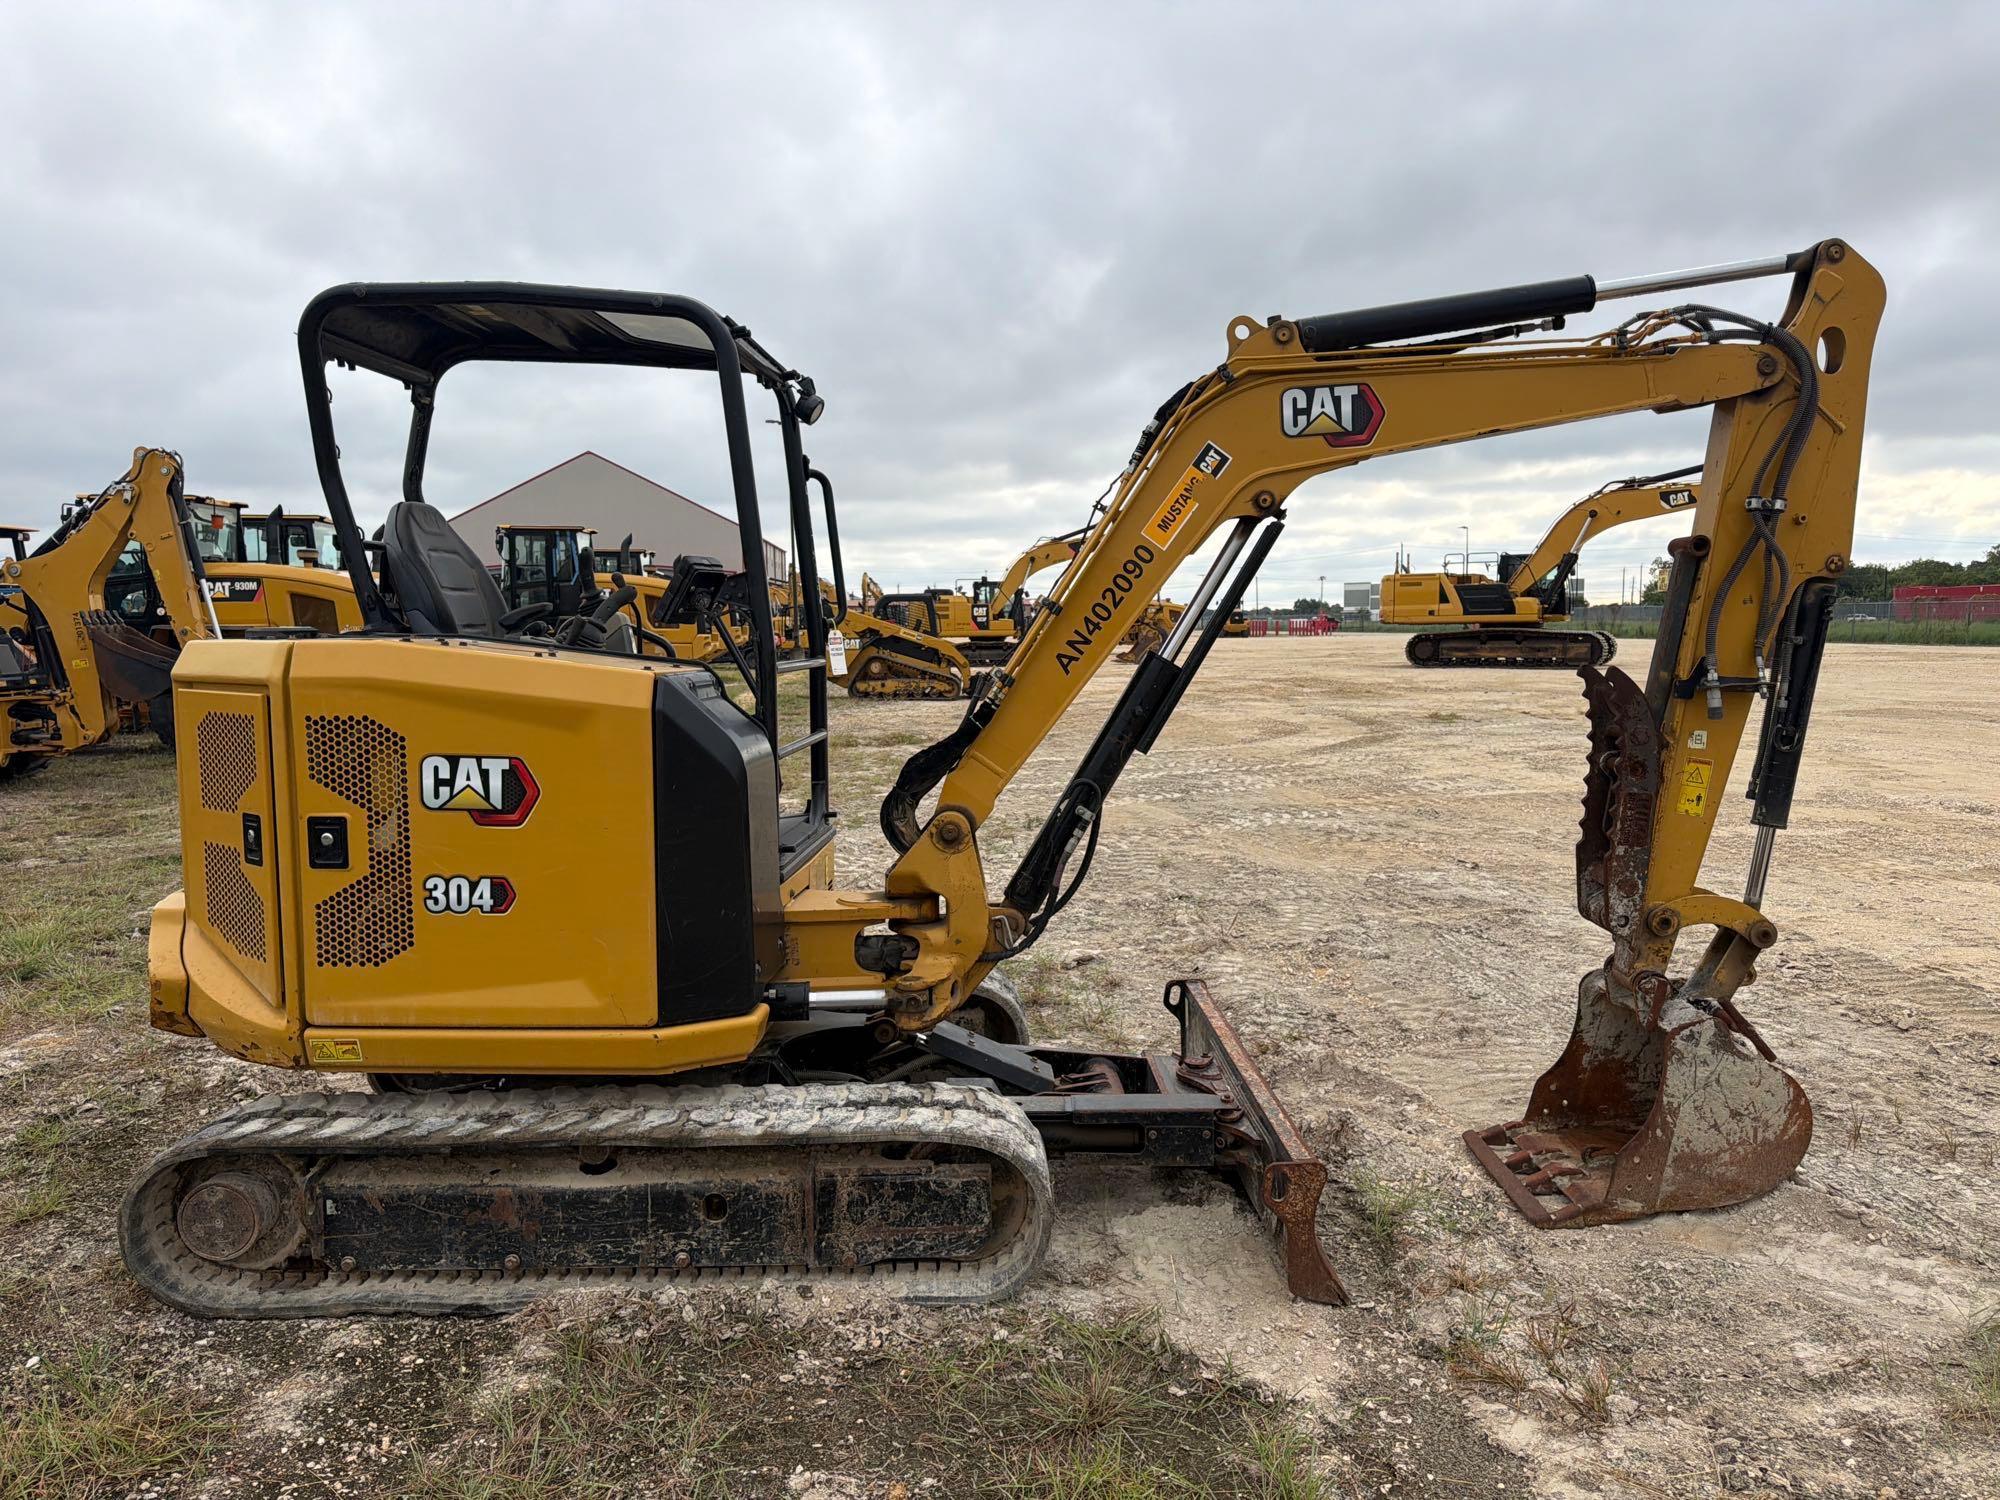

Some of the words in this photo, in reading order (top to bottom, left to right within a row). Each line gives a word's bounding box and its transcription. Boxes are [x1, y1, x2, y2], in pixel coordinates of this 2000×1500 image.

[1282, 385, 1358, 436] CAT
[1199, 448, 1222, 474] CAT
[1669, 491, 1690, 506] CAT
[205, 581, 231, 598] CAT
[234, 581, 258, 591] 930M
[973, 606, 987, 617] CAT
[1056, 544, 1154, 676] AN402090
[844, 639, 860, 650] CAT
[421, 756, 510, 809] CAT
[425, 877, 494, 912] 304
